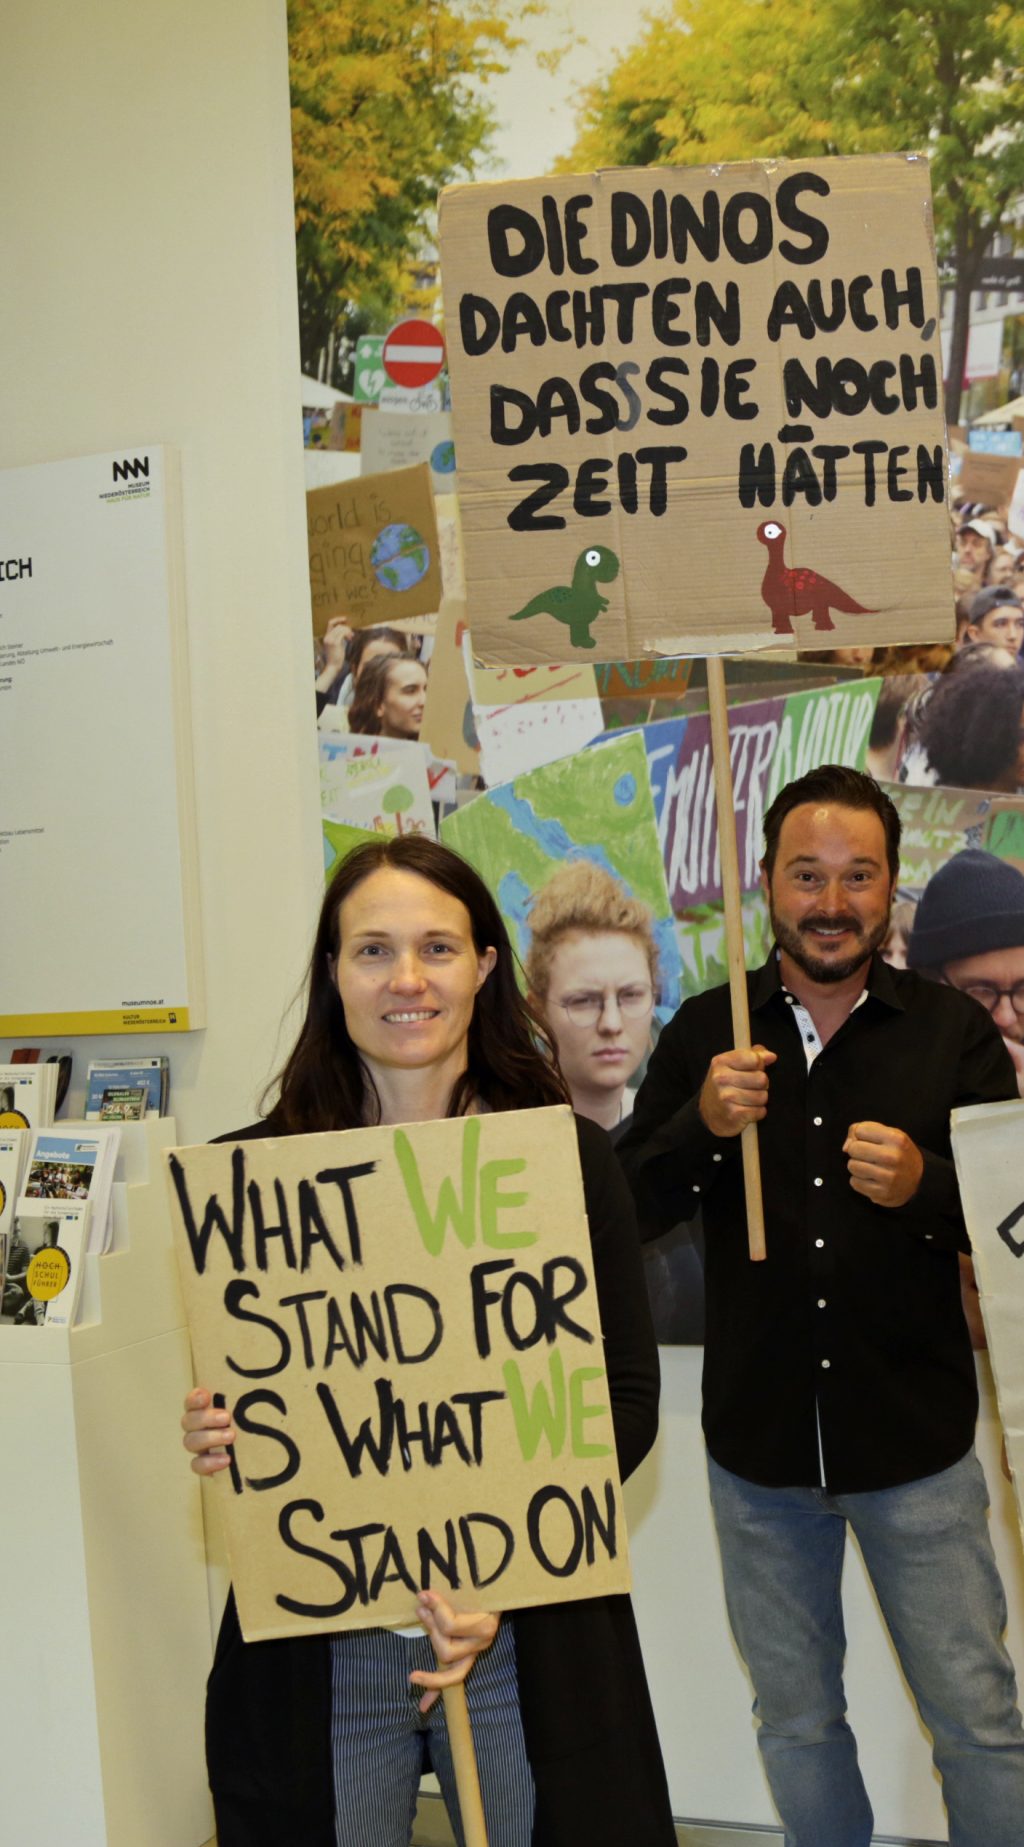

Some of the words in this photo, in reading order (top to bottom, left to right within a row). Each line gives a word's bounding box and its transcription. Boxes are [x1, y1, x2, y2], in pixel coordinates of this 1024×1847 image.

[488, 194, 599, 277] DIE
[611, 171, 831, 266] DINOS
[459, 278, 740, 356] DACHTEN
[490, 361, 641, 446] DASS
[645, 356, 760, 426] SIE
[784, 353, 938, 419] NOCH
[507, 446, 688, 532] ZEIT
[168, 1146, 382, 1275] WHAT
[393, 1117, 542, 1257] WE
[35, 1261, 61, 1270] HOCH
[224, 1279, 444, 1379] STAND
[470, 1256, 595, 1360] FOR
[212, 1388, 301, 1495] IS
[316, 1378, 507, 1479] WHAT
[502, 1346, 615, 1462] WE
[275, 1498, 516, 1619] STAND
[525, 1478, 617, 1578] ON
